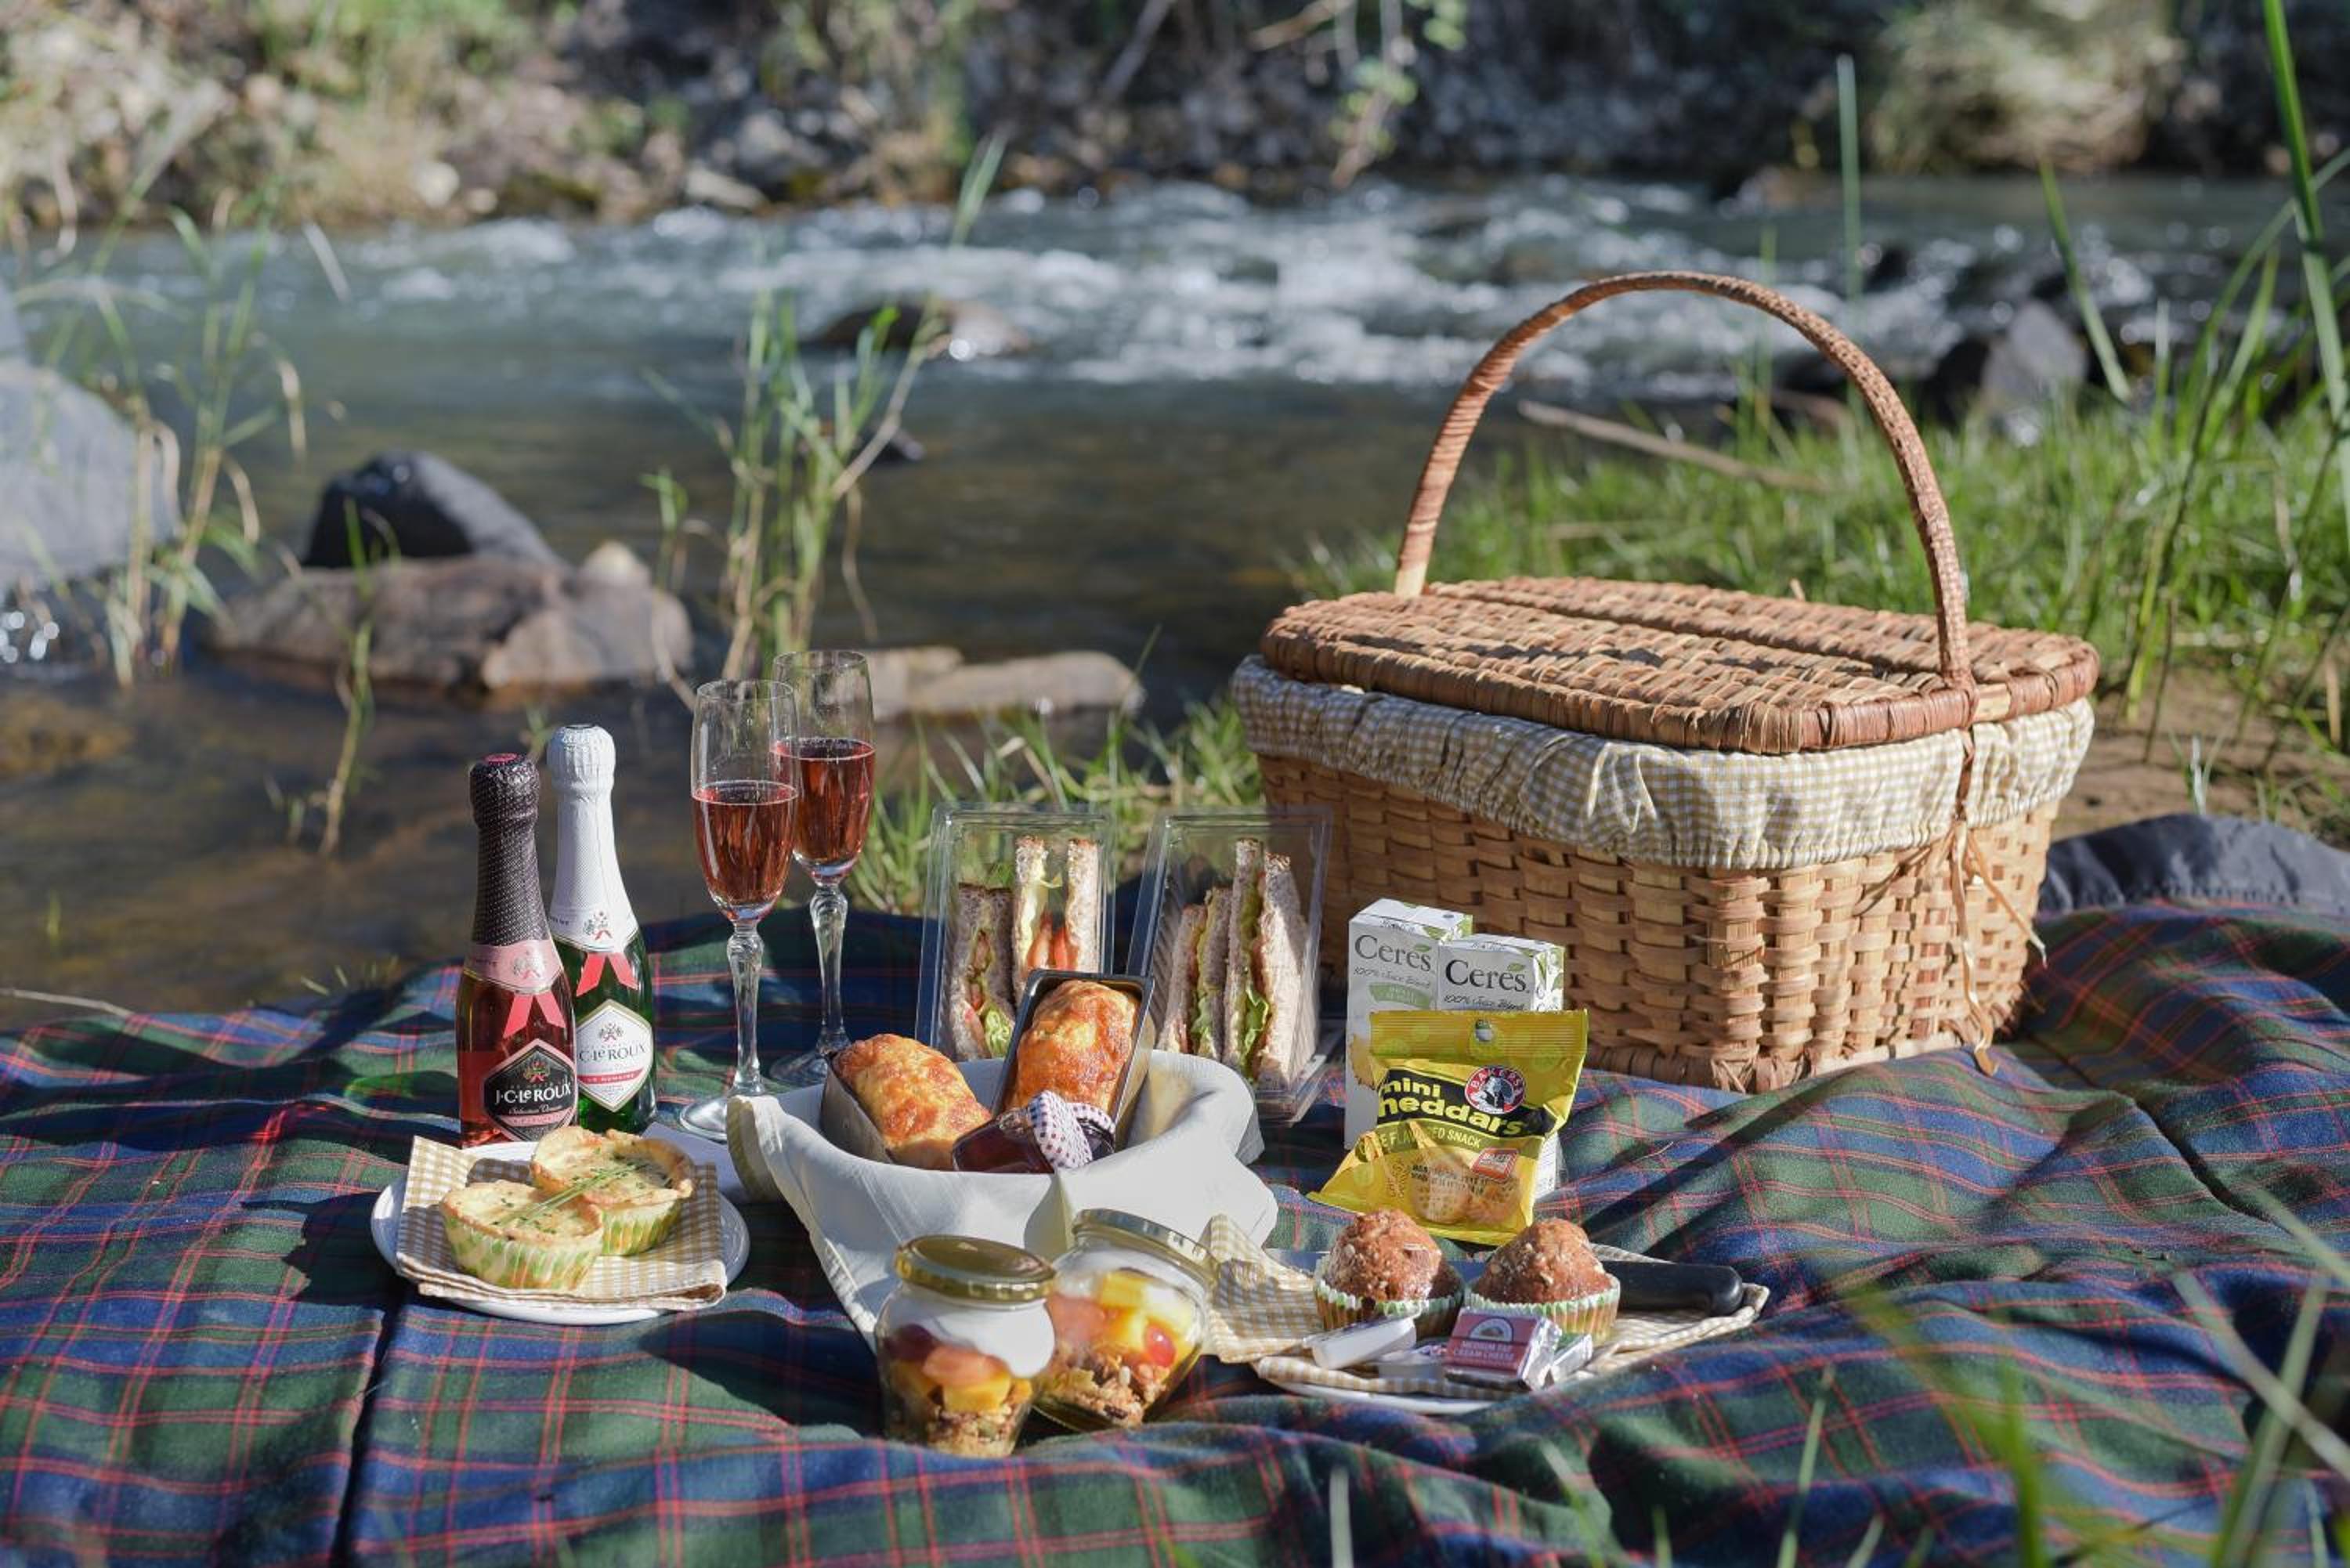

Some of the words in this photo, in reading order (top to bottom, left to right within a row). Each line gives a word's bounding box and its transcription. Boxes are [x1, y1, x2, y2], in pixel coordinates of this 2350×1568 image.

[1354, 934, 1432, 972] Ceres
[1445, 959, 1527, 992] Ceres
[1444, 994, 1470, 1005] 100%
[609, 1043, 645, 1060] ROUX
[534, 1081, 571, 1102] ROUX
[1379, 1097, 1526, 1135] heddars
[1447, 1129, 1481, 1148] SNACK
